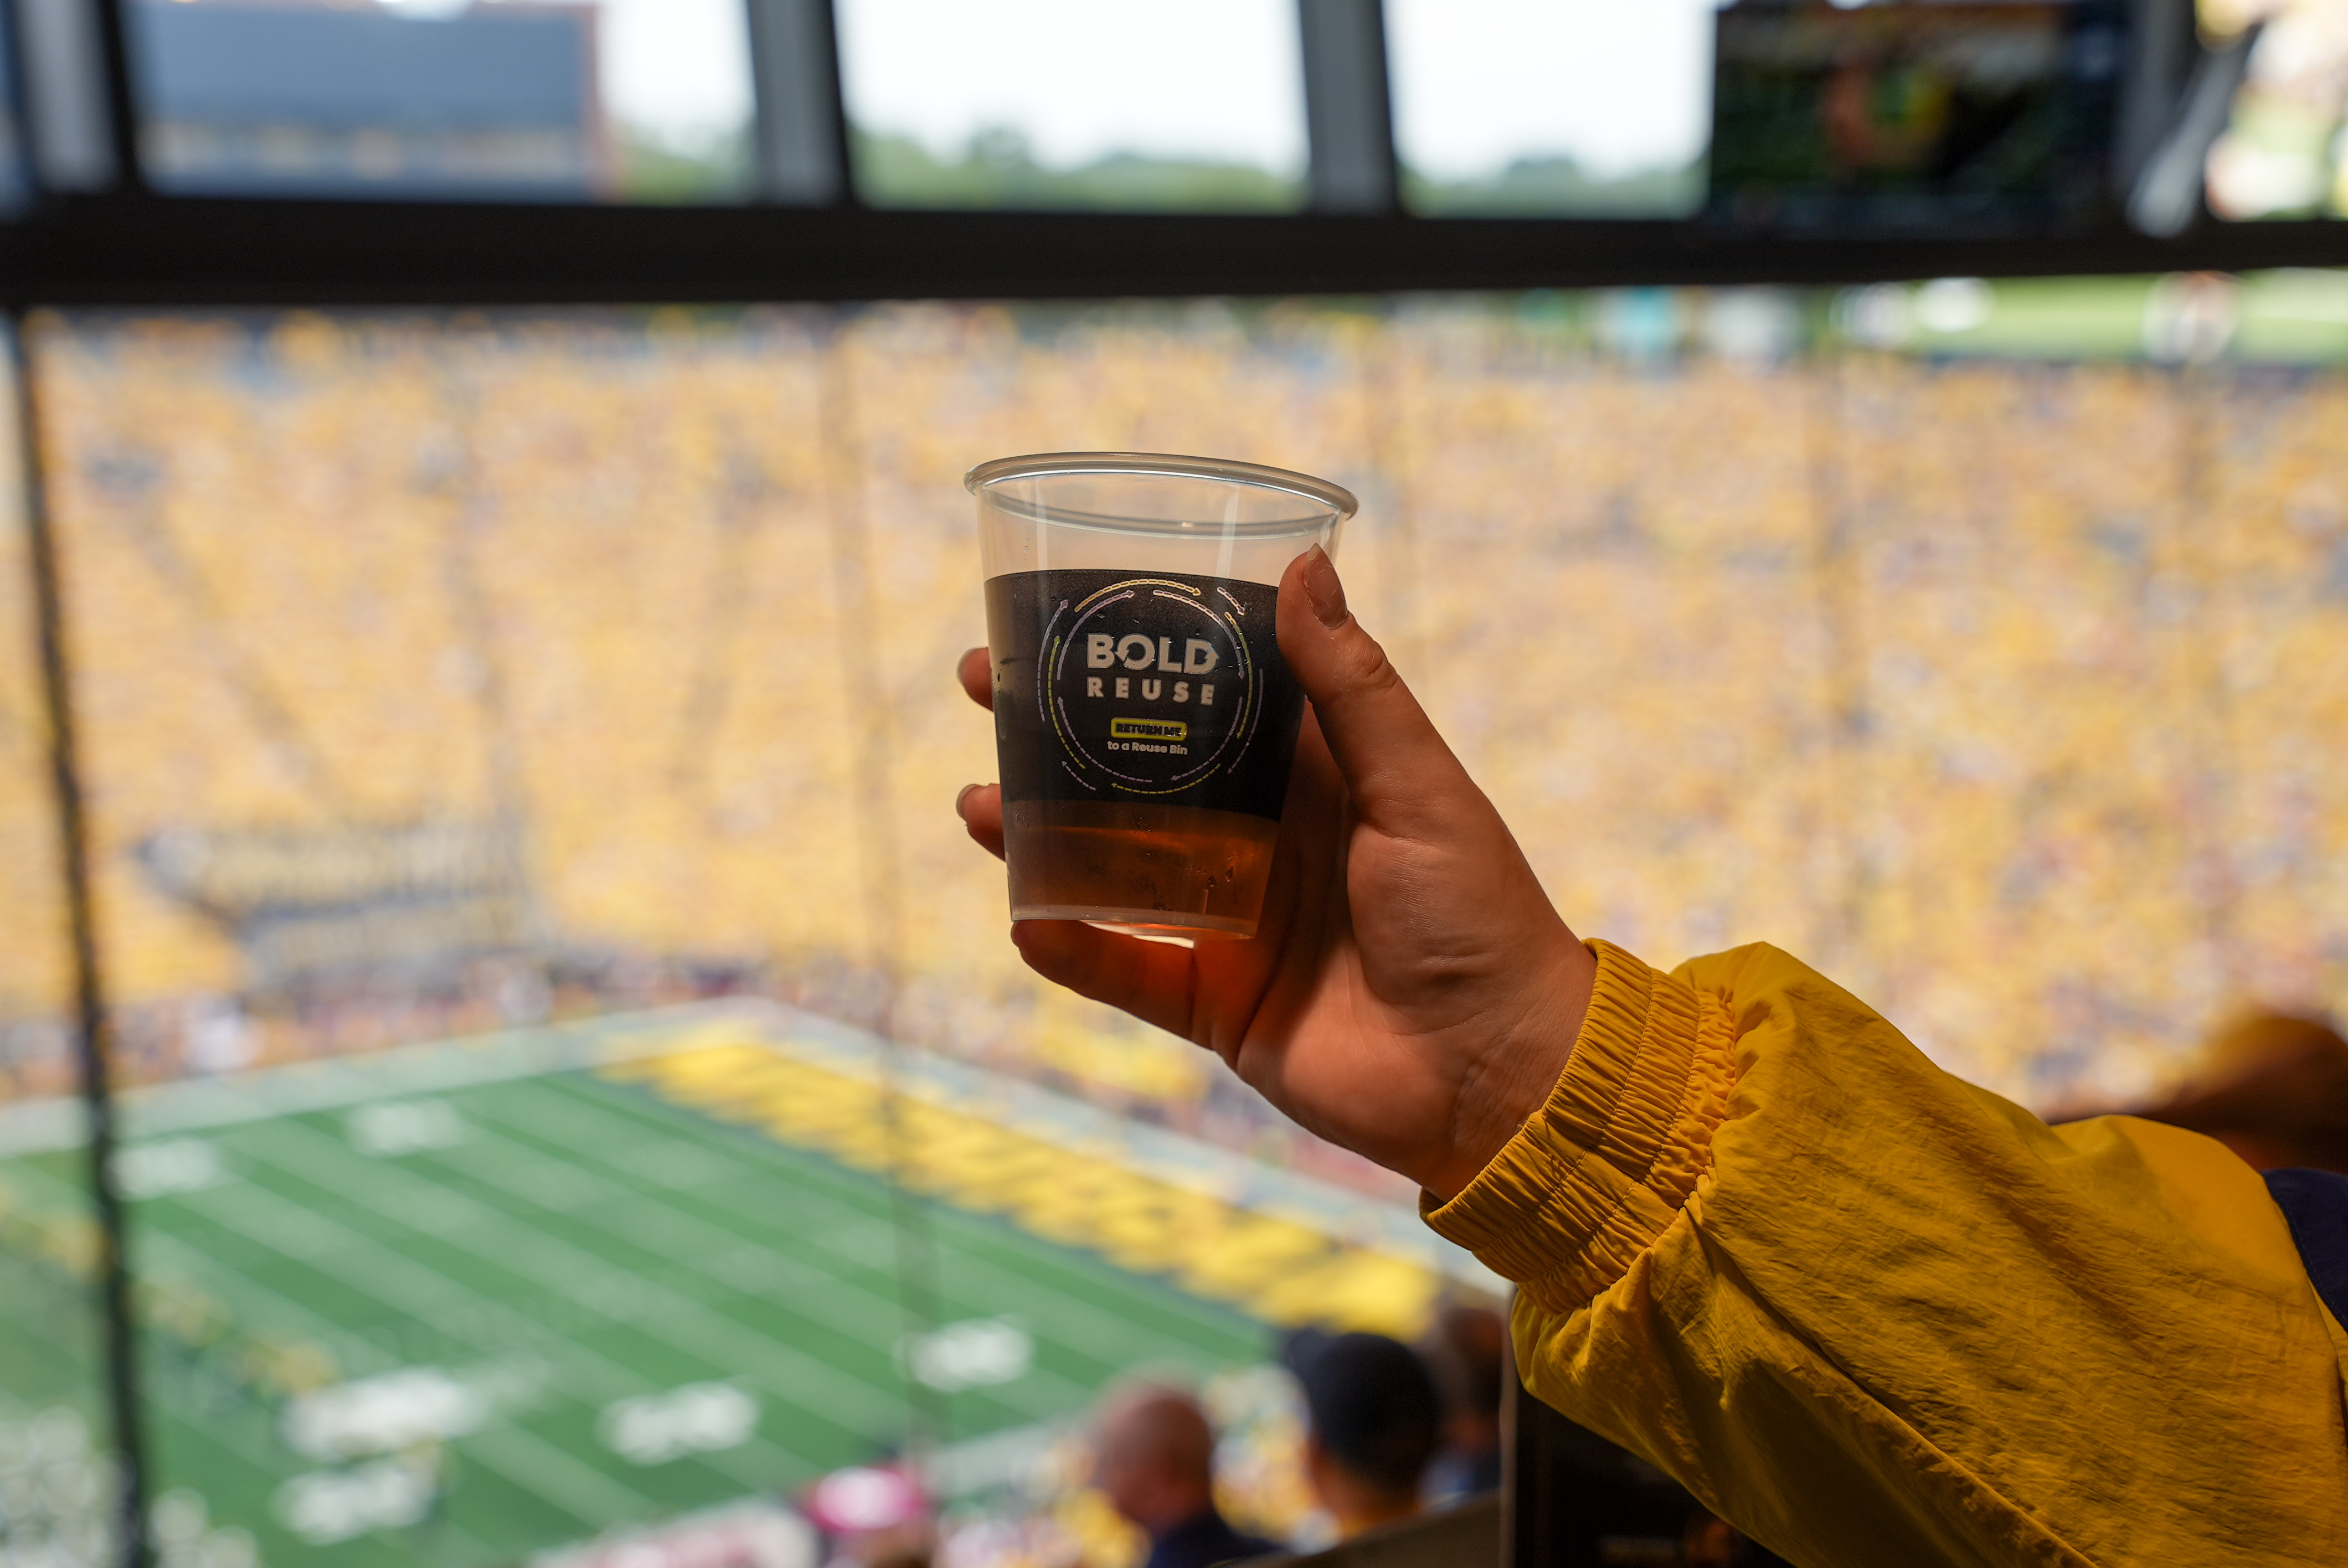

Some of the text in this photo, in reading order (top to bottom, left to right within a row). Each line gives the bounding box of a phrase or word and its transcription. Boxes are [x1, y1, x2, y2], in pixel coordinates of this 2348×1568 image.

[1087, 633, 1219, 675] BOLD
[1087, 676, 1215, 705] REUSE
[1115, 723, 1182, 736] RETURN ME
[1108, 741, 1188, 755] to a Reuse Bin
